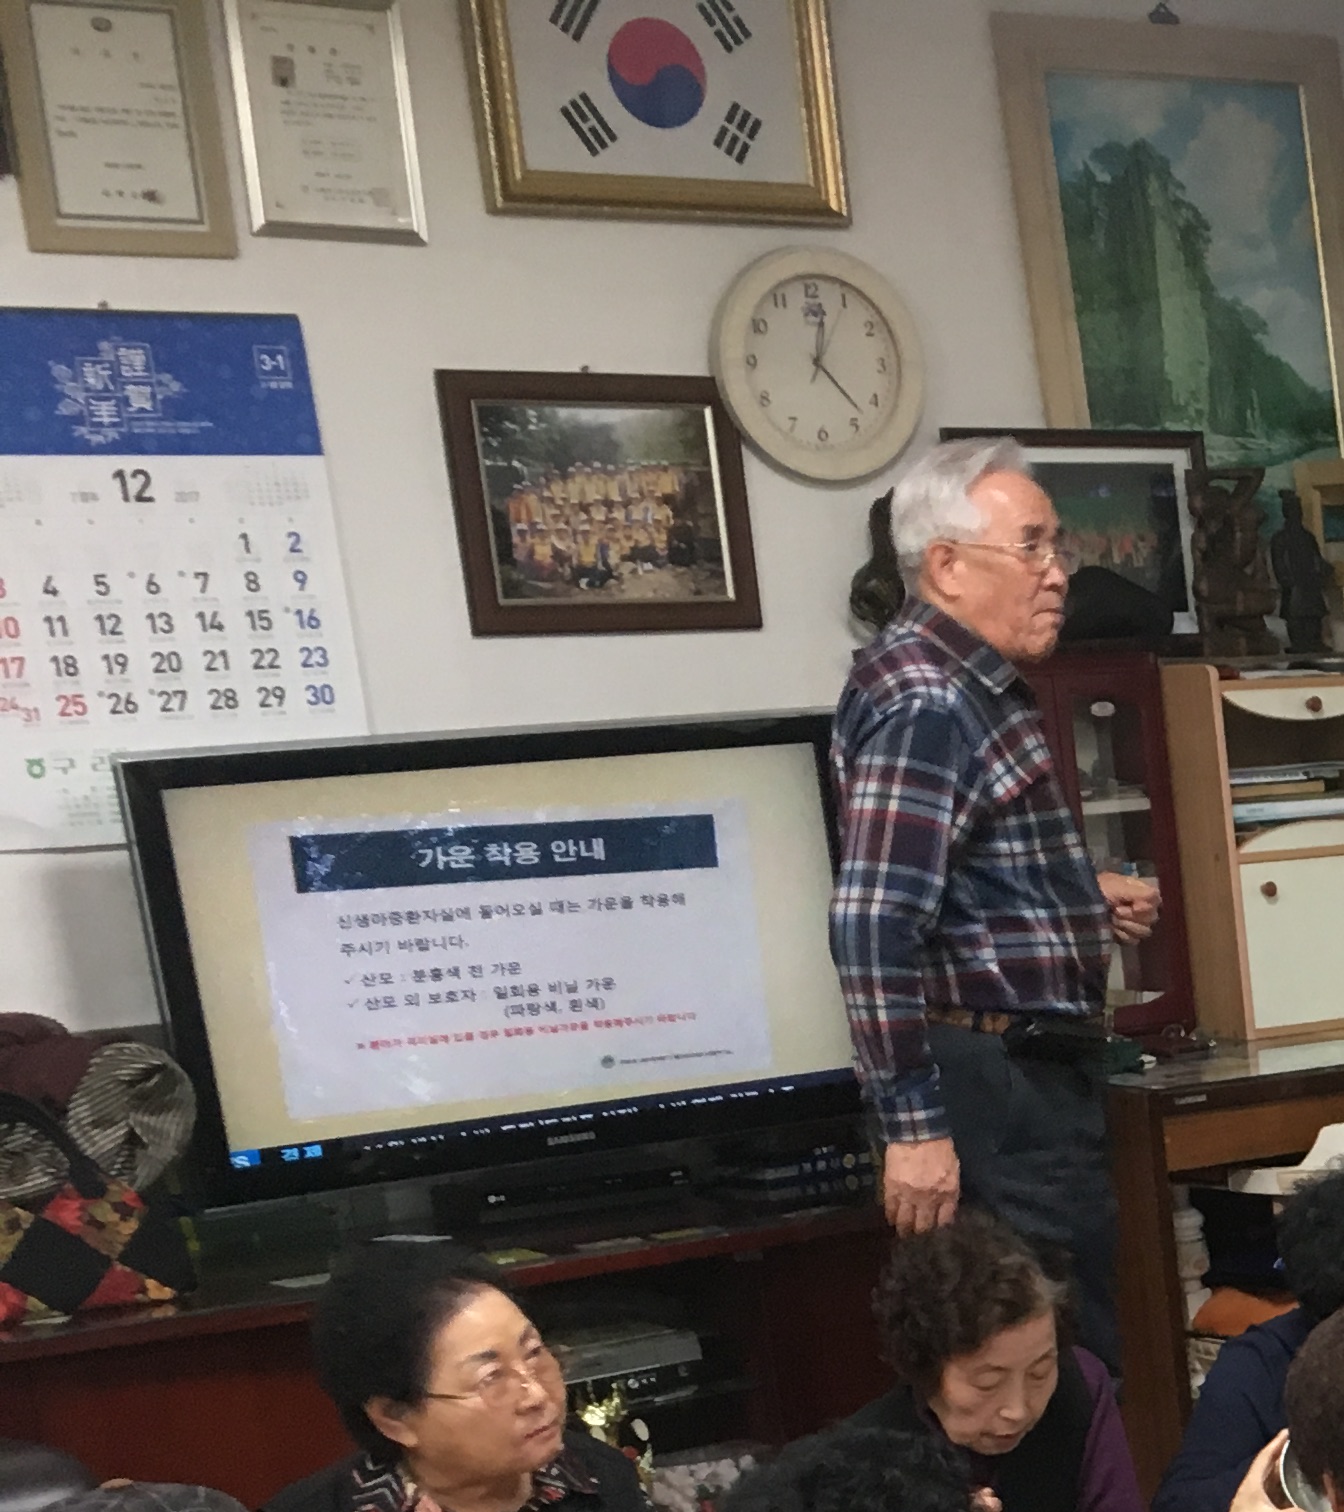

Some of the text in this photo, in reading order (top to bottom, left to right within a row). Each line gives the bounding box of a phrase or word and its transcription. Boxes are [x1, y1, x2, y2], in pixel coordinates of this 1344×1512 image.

[804, 282, 819, 299] 12
[773, 293, 787, 309] 11
[752, 318, 768, 335] 10
[864, 320, 875, 338] 2
[259, 352, 288, 372] 3-1
[876, 357, 887, 374] 3
[760, 391, 771, 408] 8
[869, 392, 879, 408] 4
[818, 424, 829, 442] 6
[850, 417, 860, 434] 5
[112, 468, 156, 503] 12
[239, 531, 303, 554] 1 2
[43, 569, 308, 597] 4 5 6 7 8 9
[43, 614, 69, 638] 11
[94, 612, 123, 636] 12
[146, 611, 175, 635] 13
[195, 610, 225, 633] 14
[245, 608, 274, 632] 15
[294, 607, 321, 630] 16
[50, 654, 80, 677] 18
[101, 652, 129, 675] 19
[151, 650, 183, 674] 20
[203, 649, 230, 672] 21
[252, 647, 282, 671] 22
[300, 646, 330, 669] 23
[55, 694, 88, 718] 25
[107, 692, 139, 715] 26
[157, 690, 188, 712] 27
[207, 687, 240, 711] 28
[257, 685, 287, 708] 29
[304, 683, 336, 706] 30
[416, 837, 606, 871] 가운 착용 안내
[339, 940, 391, 958] 주시기
[490, 961, 522, 977] 가운
[585, 976, 617, 992] 가운
